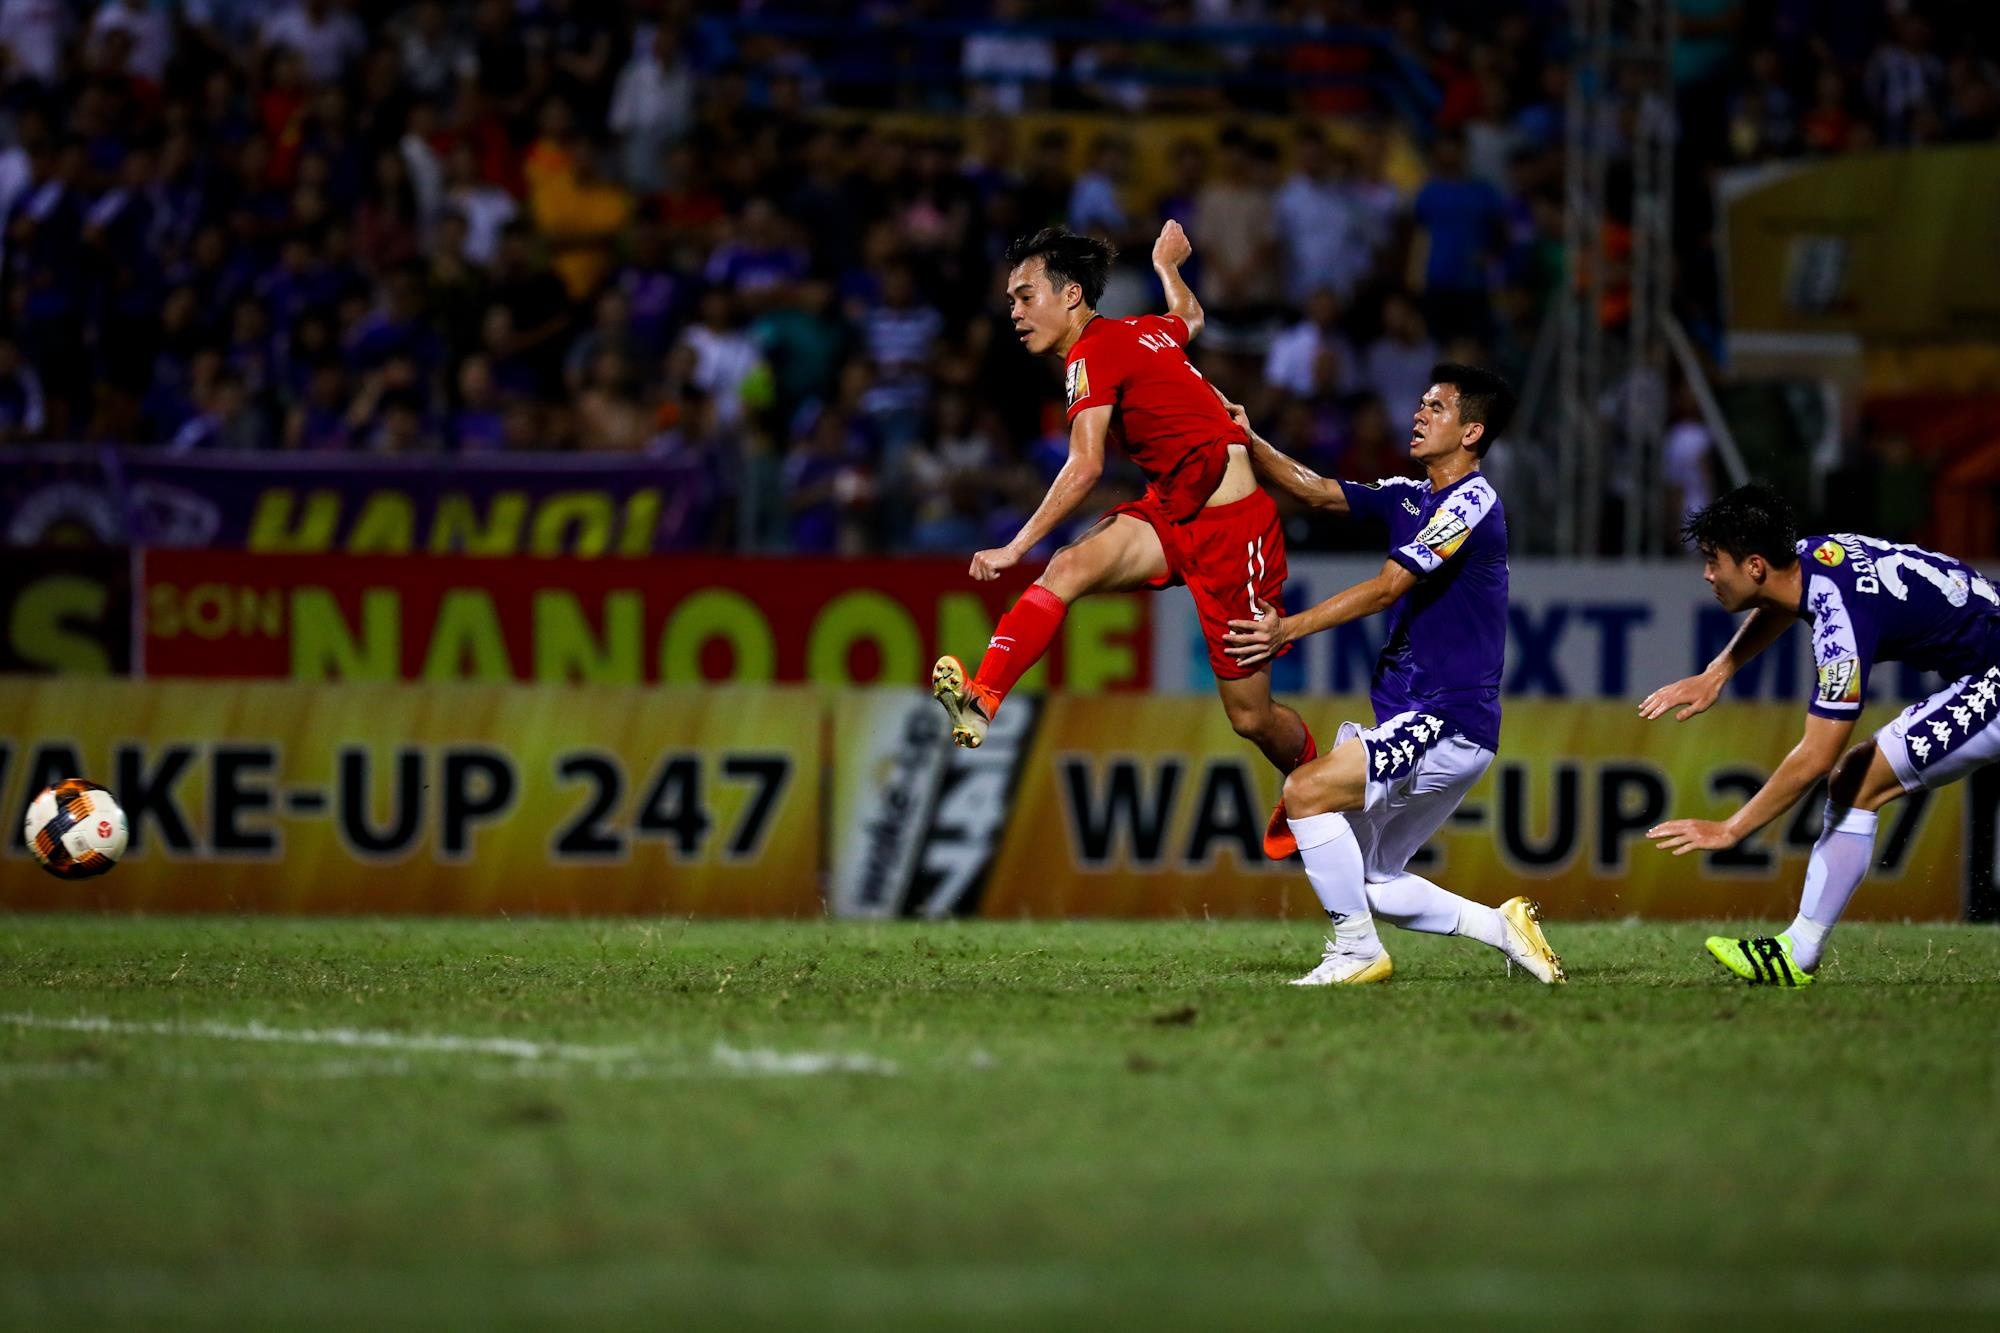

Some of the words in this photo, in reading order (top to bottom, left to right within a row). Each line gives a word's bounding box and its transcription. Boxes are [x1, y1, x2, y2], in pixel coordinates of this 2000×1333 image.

[1334, 606, 1649, 693] NXT
[0, 749, 515, 856] KE-UP
[554, 754, 791, 859] 247
[1067, 763, 1665, 864] WA-UP
